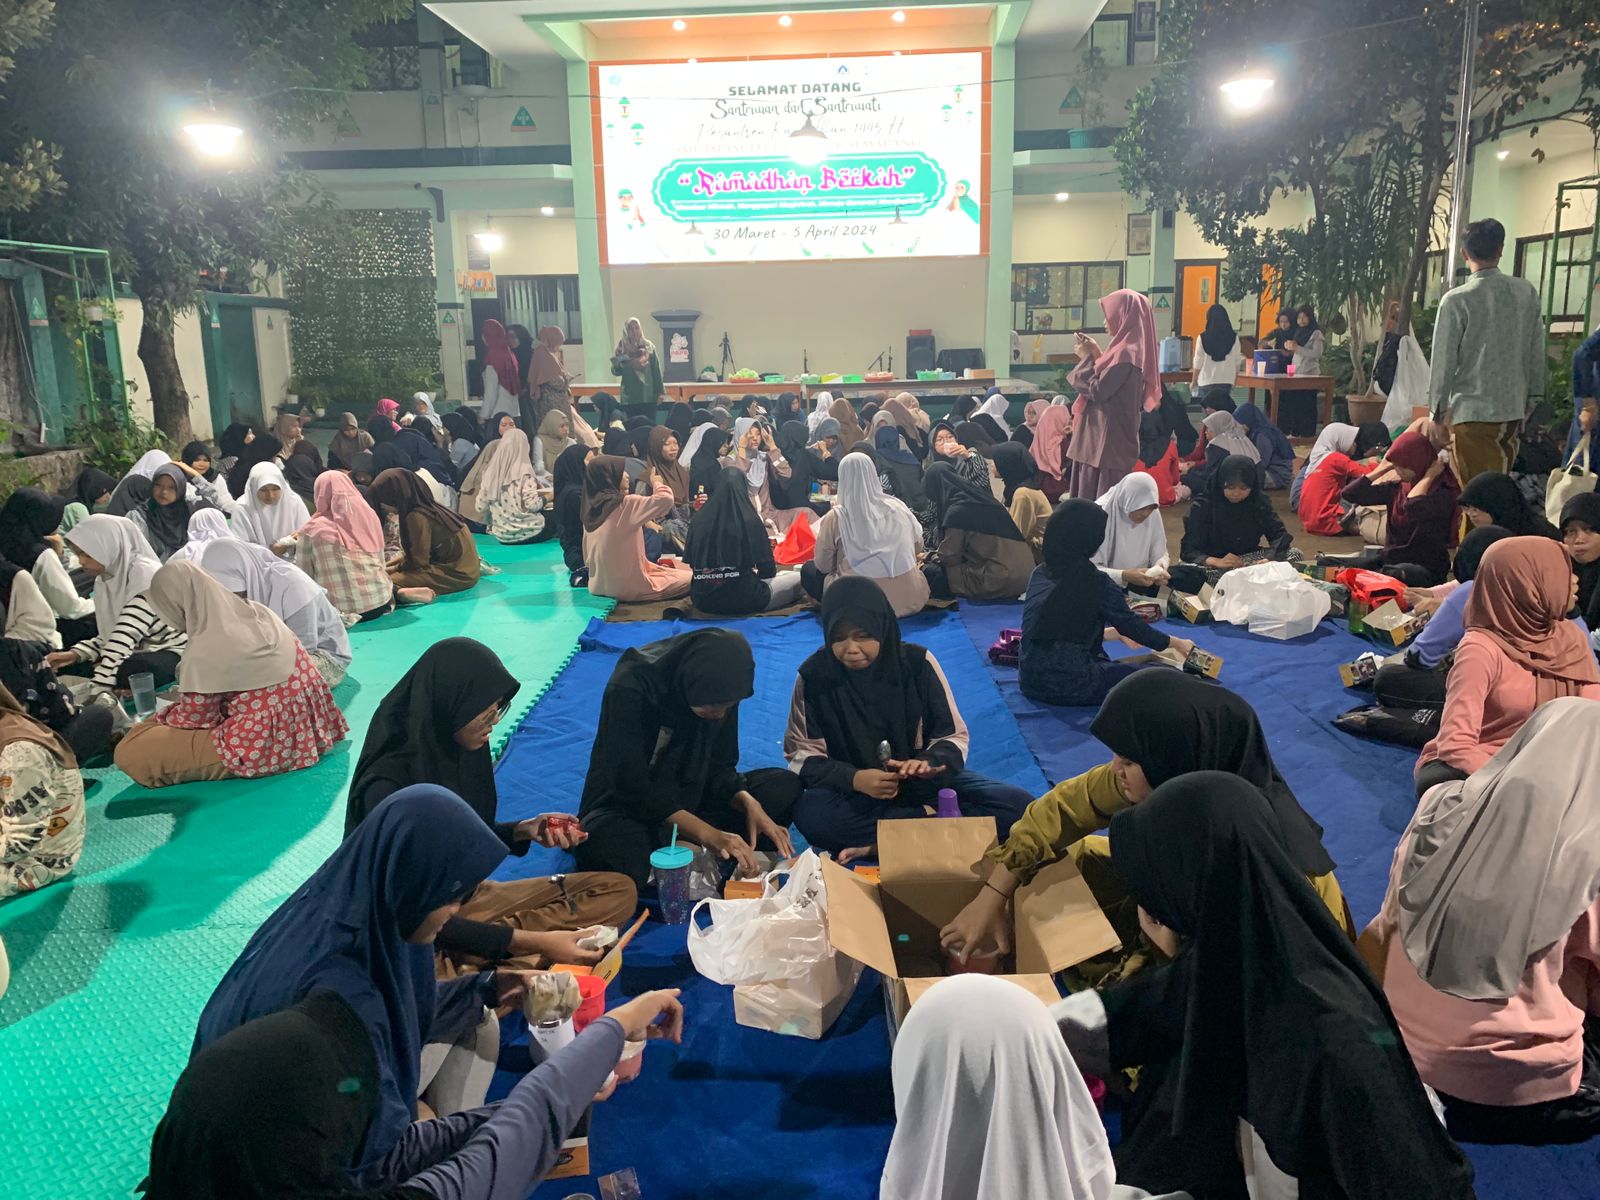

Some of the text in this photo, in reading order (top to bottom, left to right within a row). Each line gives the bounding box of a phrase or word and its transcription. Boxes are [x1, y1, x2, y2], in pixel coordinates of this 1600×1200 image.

[728, 82, 862, 96] SELAMAT DATANG
[713, 228, 730, 239] 30
[734, 225, 776, 239] Maret
[794, 225, 801, 237] 5
[806, 223, 839, 240] April
[842, 224, 878, 236] 2024
